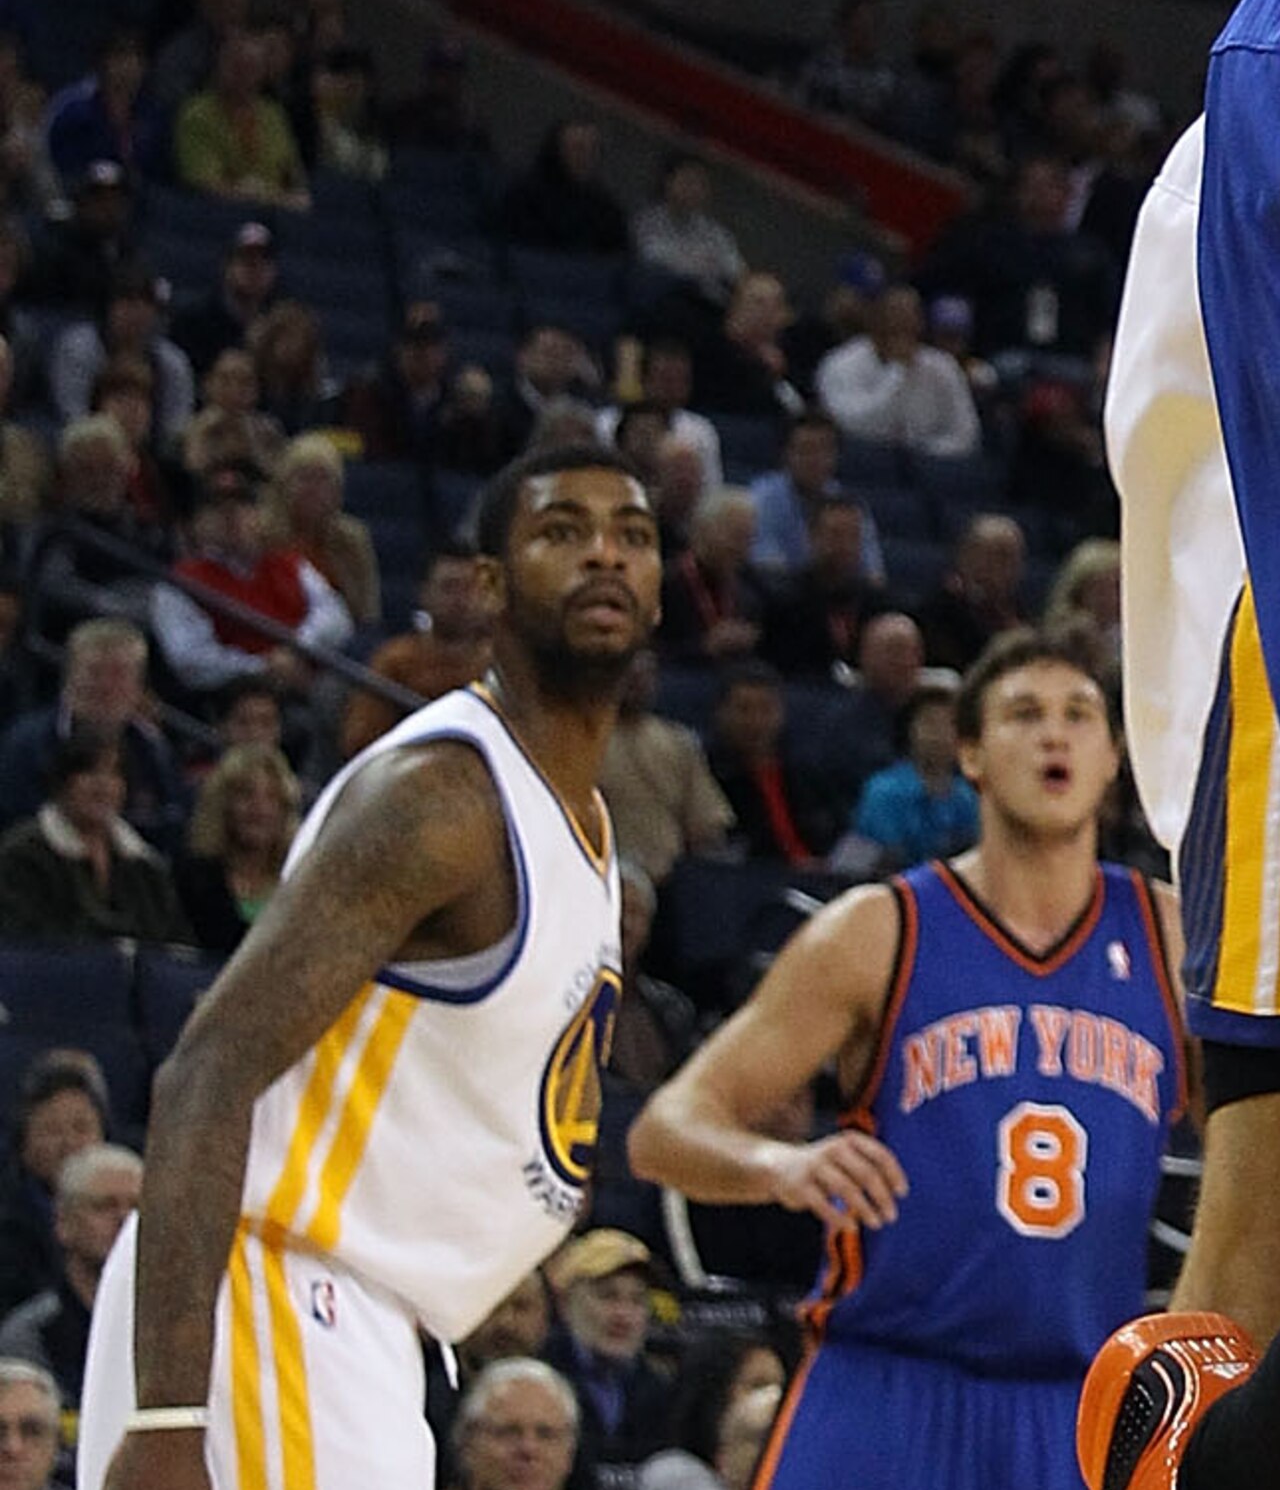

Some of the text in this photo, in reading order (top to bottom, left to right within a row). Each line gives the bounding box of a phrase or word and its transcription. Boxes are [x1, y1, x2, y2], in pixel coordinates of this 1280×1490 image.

[901, 1004, 1165, 1127] NEW YORK
[996, 1101, 1089, 1239] 8
